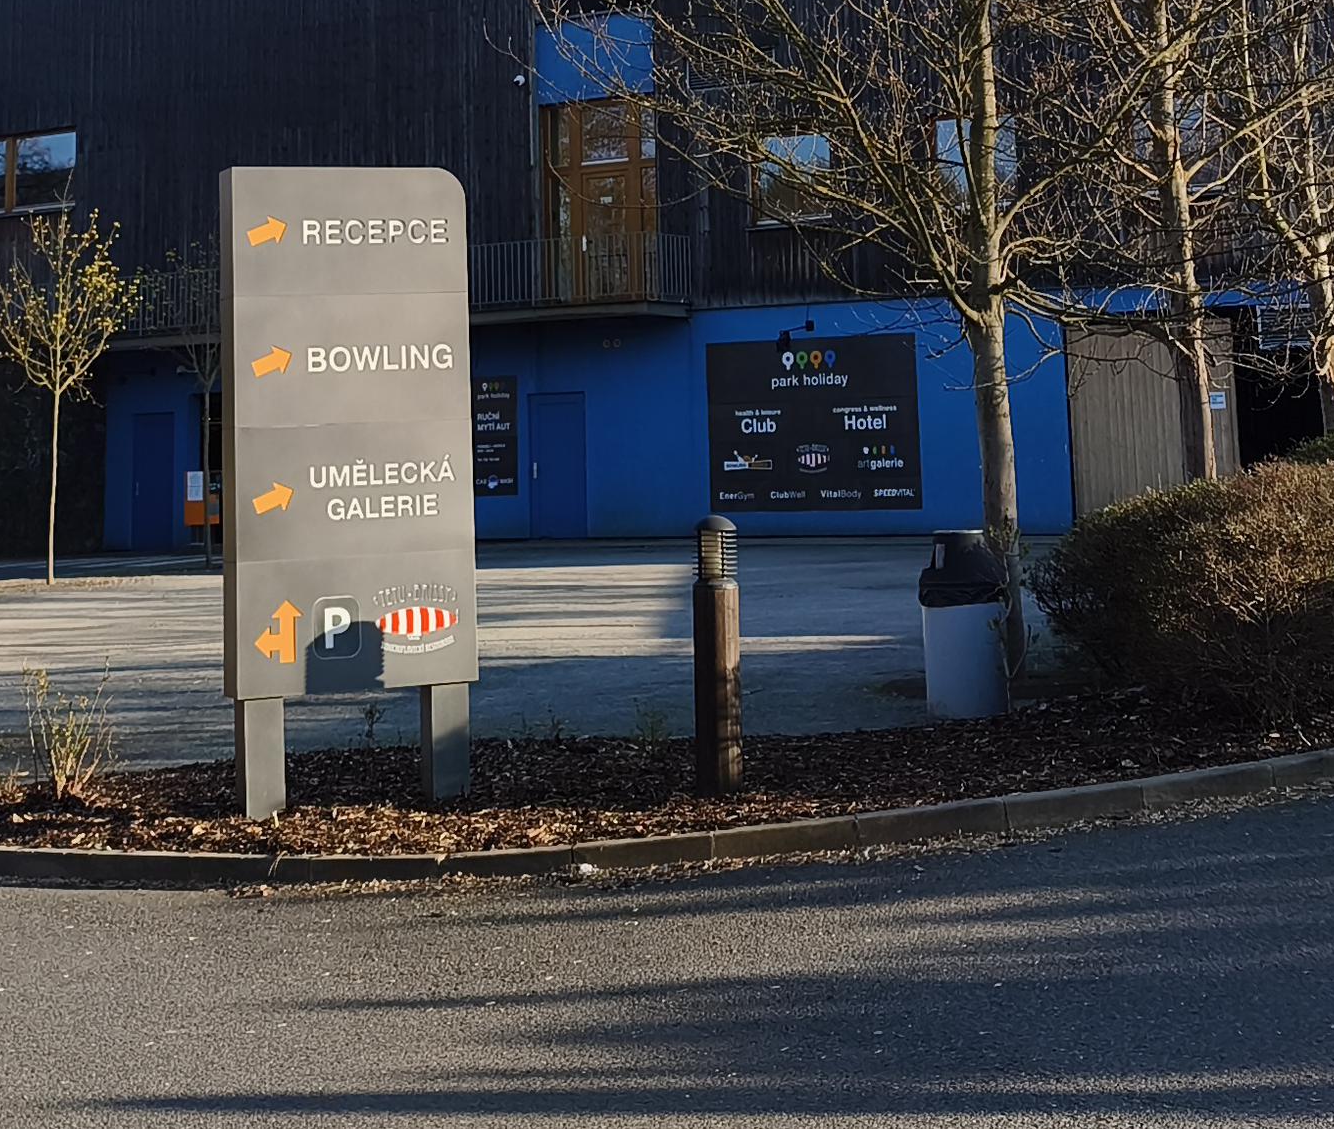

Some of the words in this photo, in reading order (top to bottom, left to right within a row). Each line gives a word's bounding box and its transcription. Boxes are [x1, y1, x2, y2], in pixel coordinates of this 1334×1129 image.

[302, 218, 450, 246] RECEPCE
[306, 343, 454, 373] BOWLING
[771, 374, 799, 390] park
[803, 372, 848, 387] holiday
[741, 417, 777, 434] Club
[844, 413, 887, 430] Hotel
[308, 454, 456, 489] UMĚLECKÁ
[326, 494, 439, 521] GALERIE
[820, 489, 862, 499] VitalBody
[324, 606, 352, 650] P
